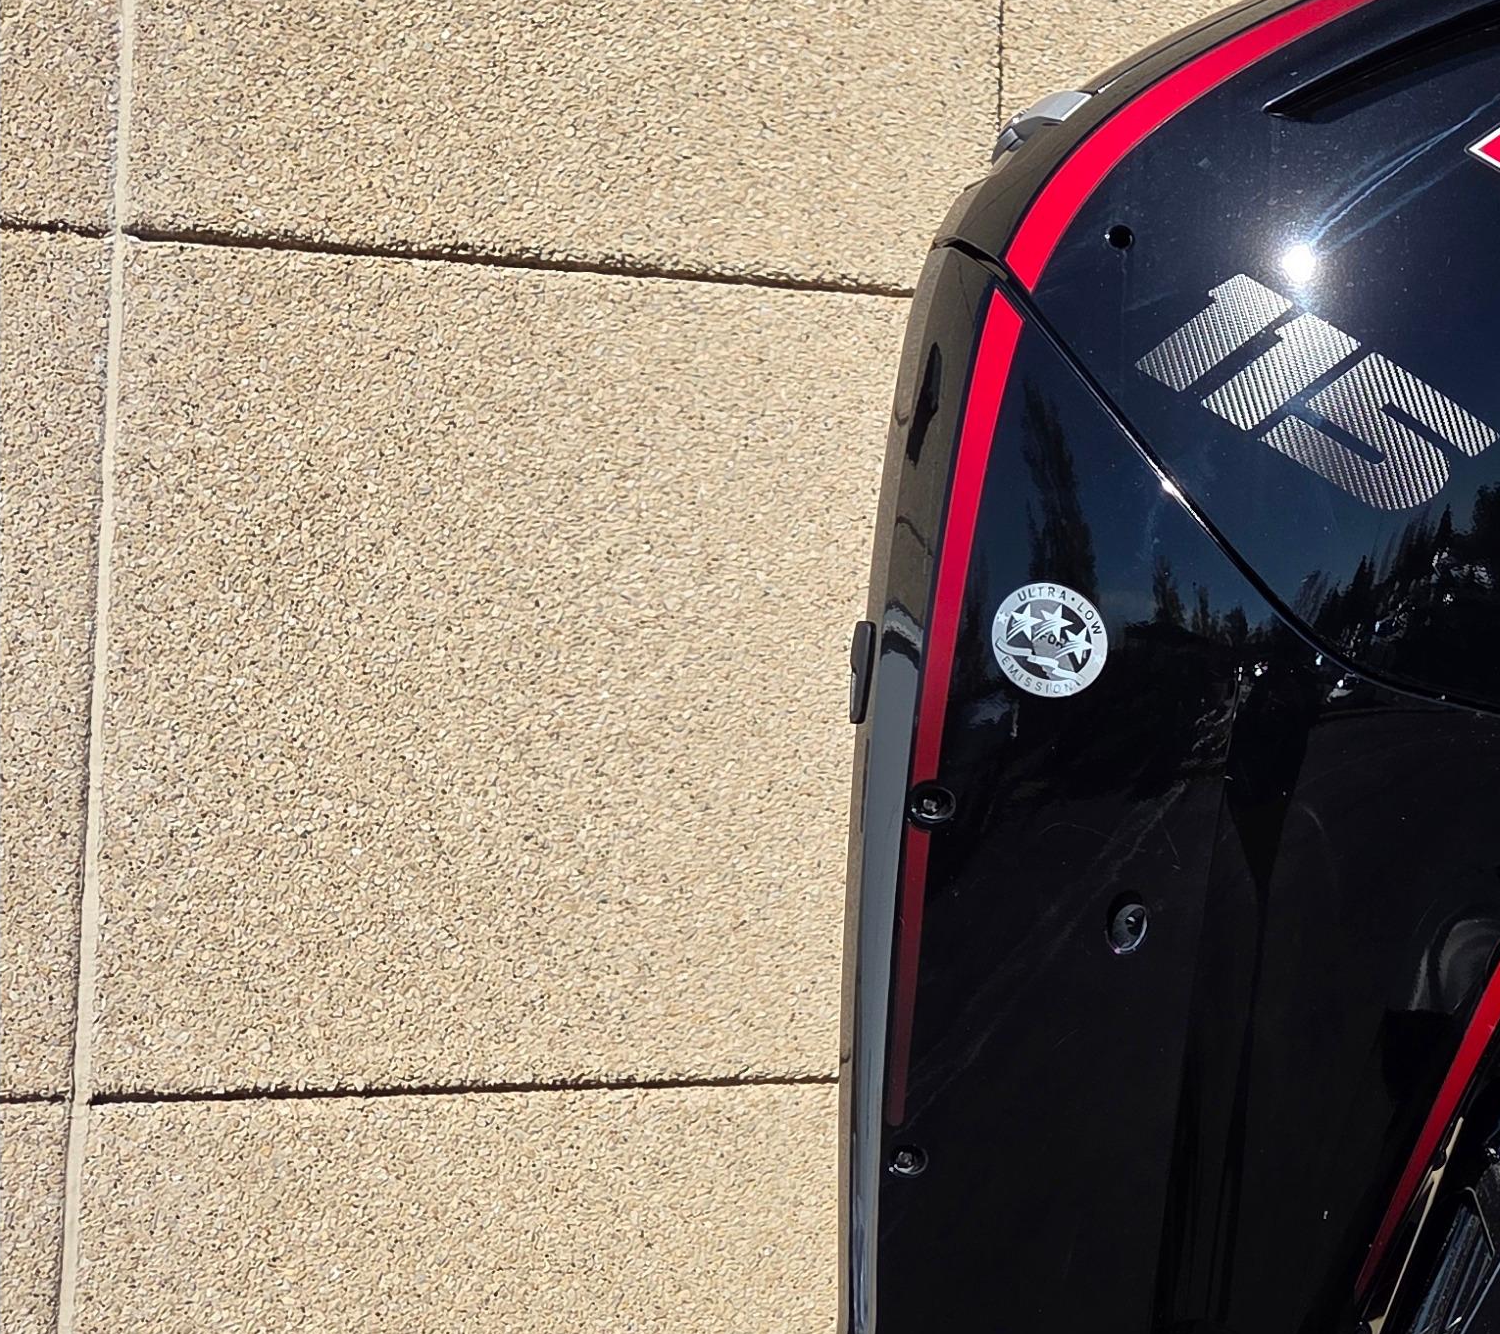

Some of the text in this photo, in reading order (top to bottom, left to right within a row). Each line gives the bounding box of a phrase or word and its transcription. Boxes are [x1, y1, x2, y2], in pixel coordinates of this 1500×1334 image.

[1134, 273, 1500, 510] 115
[1016, 586, 1102, 635] ULTRA LOW
[1001, 656, 1074, 694] EMISSION
